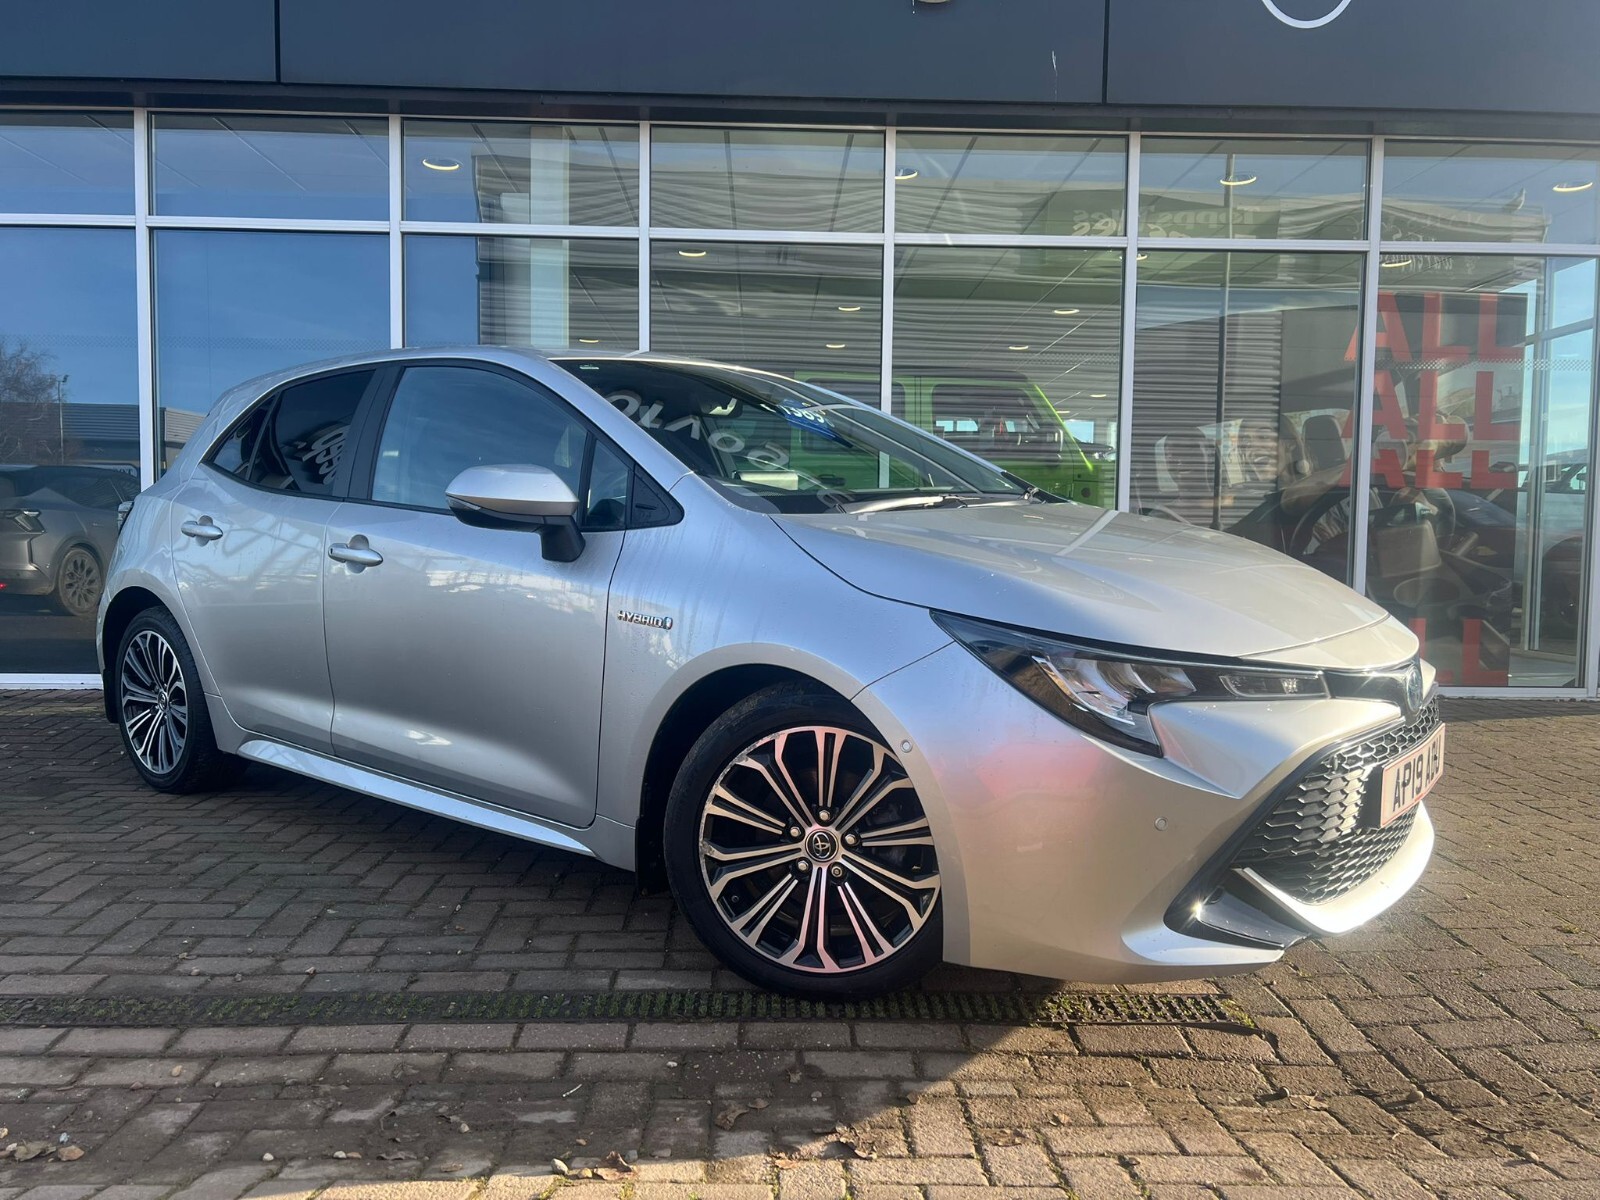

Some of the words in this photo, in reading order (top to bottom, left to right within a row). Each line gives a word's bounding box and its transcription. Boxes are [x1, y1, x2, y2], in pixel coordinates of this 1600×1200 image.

[1344, 291, 1525, 361] ALL
[1341, 370, 1519, 441] ALL
[1338, 449, 1518, 489] ALL
[617, 609, 664, 629] HYBRID
[1393, 754, 1424, 812] AP19
